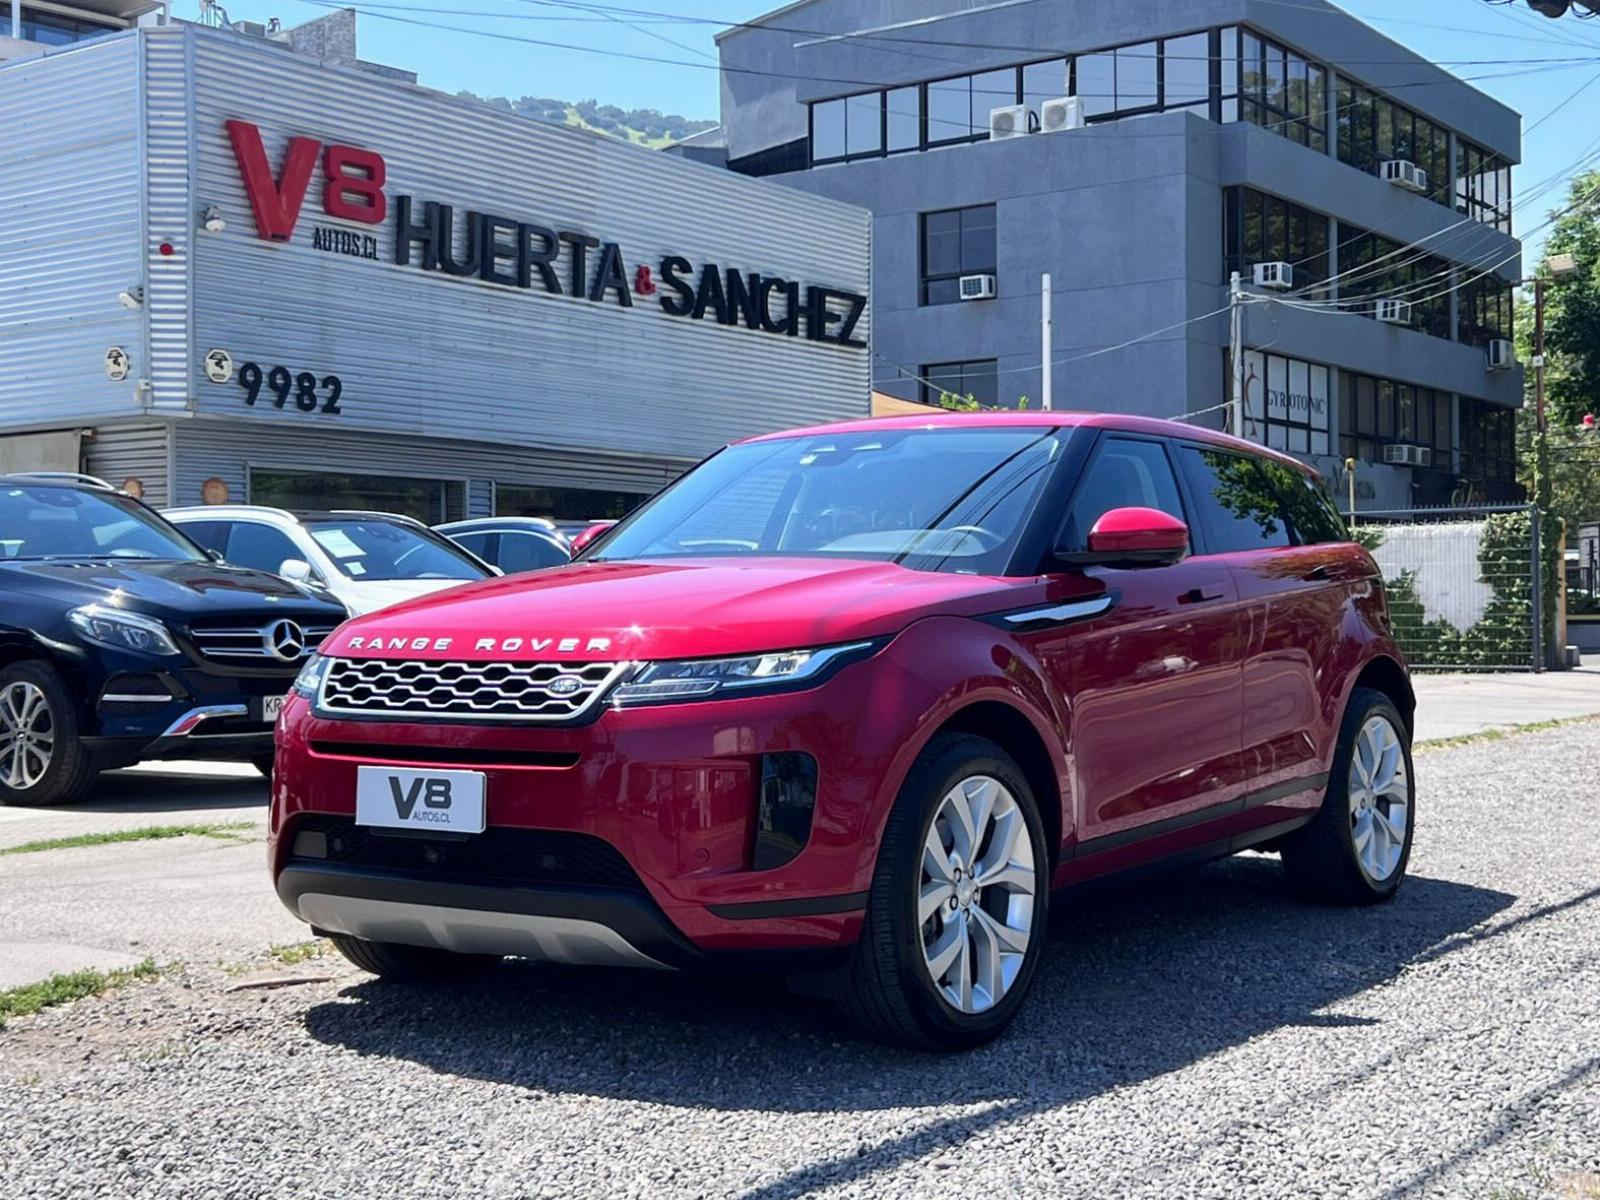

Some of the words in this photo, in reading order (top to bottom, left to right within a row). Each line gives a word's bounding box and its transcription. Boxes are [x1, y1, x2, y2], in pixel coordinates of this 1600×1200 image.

[224, 118, 387, 243] V8
[312, 226, 380, 261] AUTOS.CL
[394, 195, 633, 308] HUERTA
[634, 263, 656, 297] &
[659, 254, 868, 349] SANCHEZ
[239, 361, 343, 415] 9982
[347, 637, 453, 651] RANGE
[475, 637, 612, 652] ROVER
[388, 776, 452, 820] V8
[413, 810, 452, 824] AUTOS.CL
